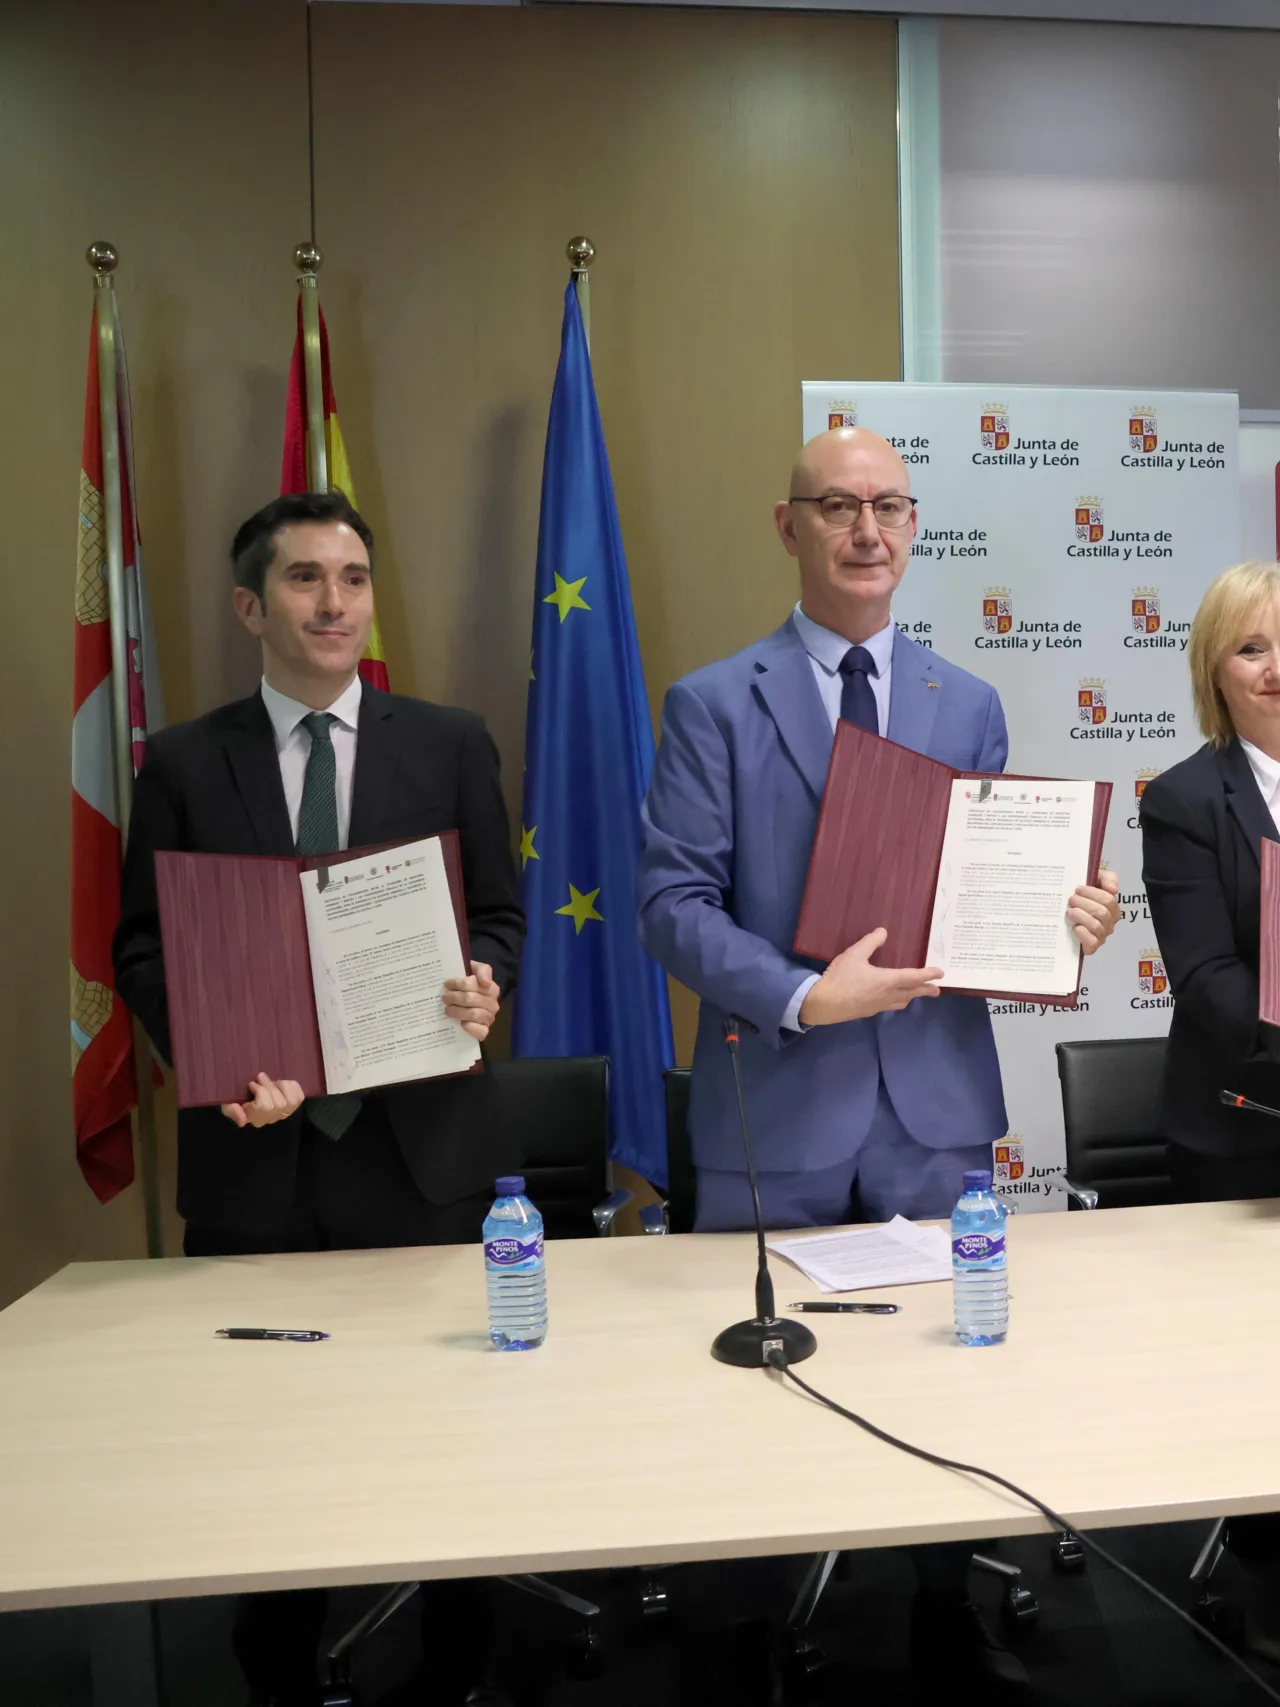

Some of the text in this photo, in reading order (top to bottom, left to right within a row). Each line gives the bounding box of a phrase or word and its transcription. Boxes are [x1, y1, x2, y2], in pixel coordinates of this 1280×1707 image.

[911, 436, 929, 448] de
[1013, 438, 1079, 451] Junta de
[1161, 441, 1225, 453] Junta de
[901, 452, 930, 464] eón
[972, 453, 1079, 469] Castilla y León
[1121, 455, 1225, 471] Castilla y León
[921, 529, 987, 541] Junta de
[1108, 530, 1172, 542] Junta de
[936, 547, 946, 560] y
[950, 545, 987, 556] León
[1067, 545, 1173, 561] Castilla y León
[913, 621, 932, 633] de
[1016, 621, 1082, 633] Junta de
[1164, 620, 1191, 632] Jun
[974, 636, 1082, 652] Castilla y León
[1124, 636, 1188, 651] Castilla y
[1111, 711, 1175, 723] Junta de
[1070, 726, 1176, 742] Castilla y León
[1129, 910, 1138, 923] y
[1130, 996, 1173, 1009] Castill
[1039, 1004, 1048, 1016] y
